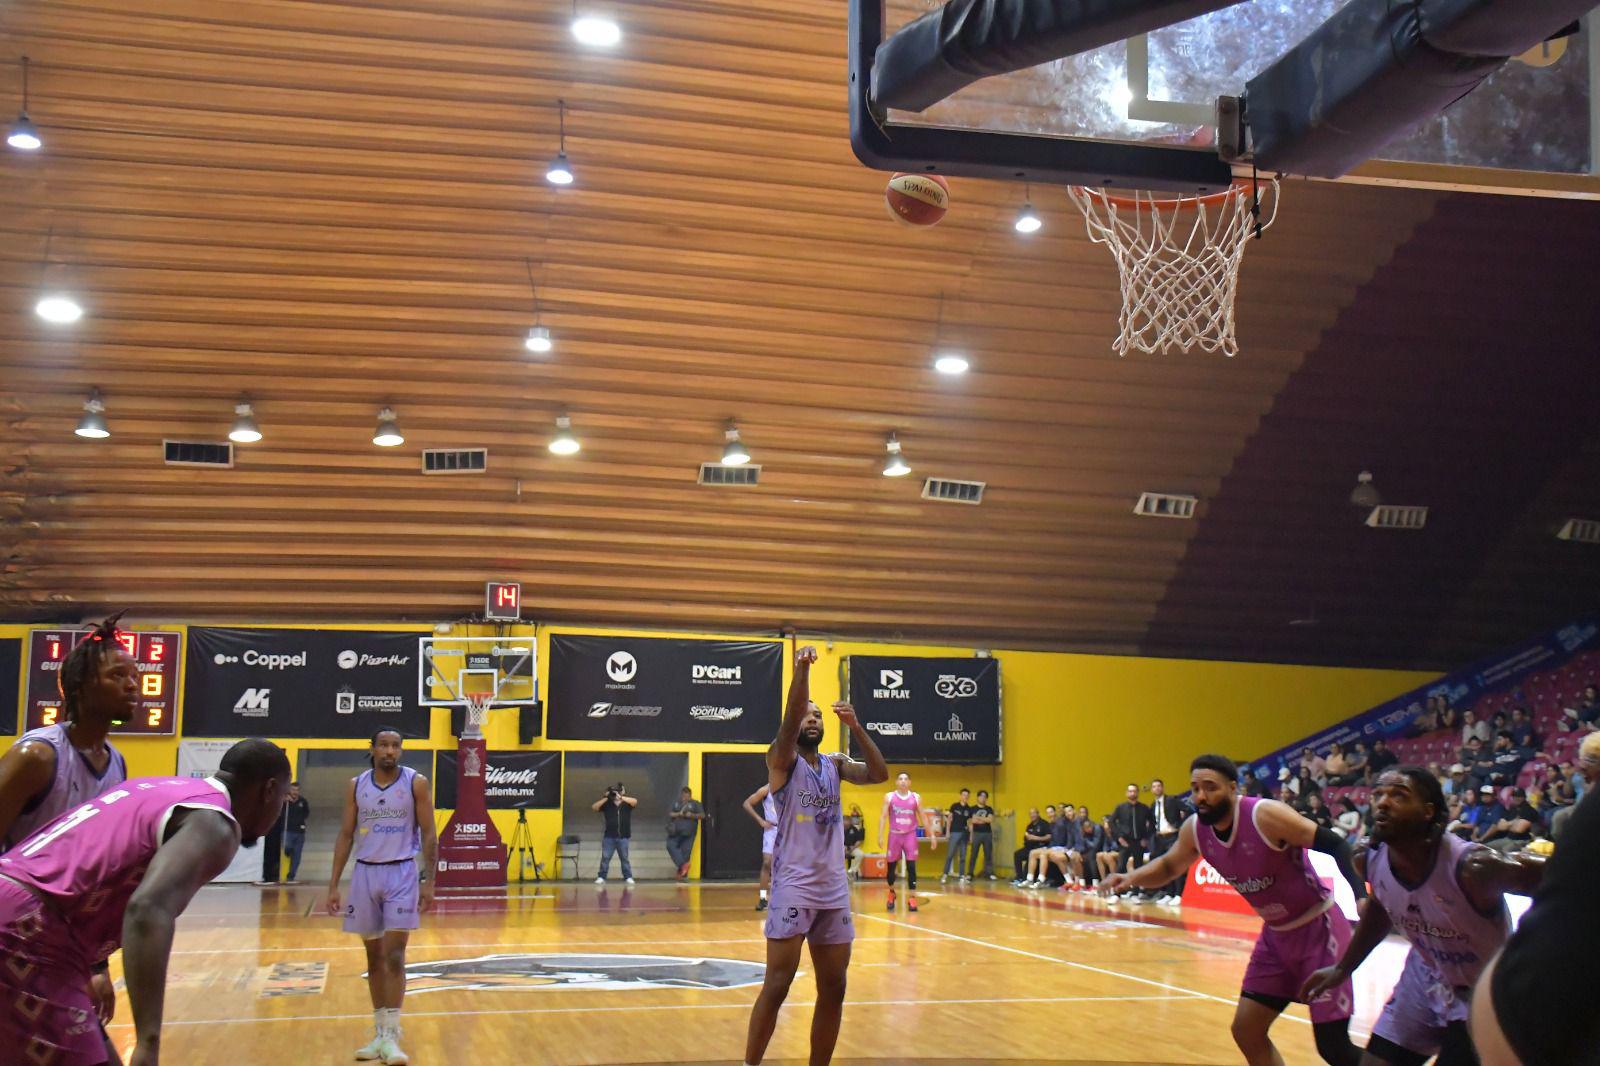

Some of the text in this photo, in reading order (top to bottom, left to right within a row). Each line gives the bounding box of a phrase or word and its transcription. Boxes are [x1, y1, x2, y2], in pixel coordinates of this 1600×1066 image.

[903, 180, 943, 205] SPALDING
[497, 586, 517, 608] 14
[51, 643, 59, 659] 1
[150, 644, 163, 661] 2
[243, 650, 307, 670] Coppel
[358, 654, 411, 667] Pizza Hut
[692, 664, 742, 680] D'Gari
[873, 688, 910, 699] NEW PLAY
[935, 677, 978, 699] exa
[43, 707, 57, 725] 2
[148, 708, 162, 726] 2
[866, 722, 914, 731] EXTREME
[934, 731, 977, 741] CLAMONT
[463, 823, 487, 833] ISDE
